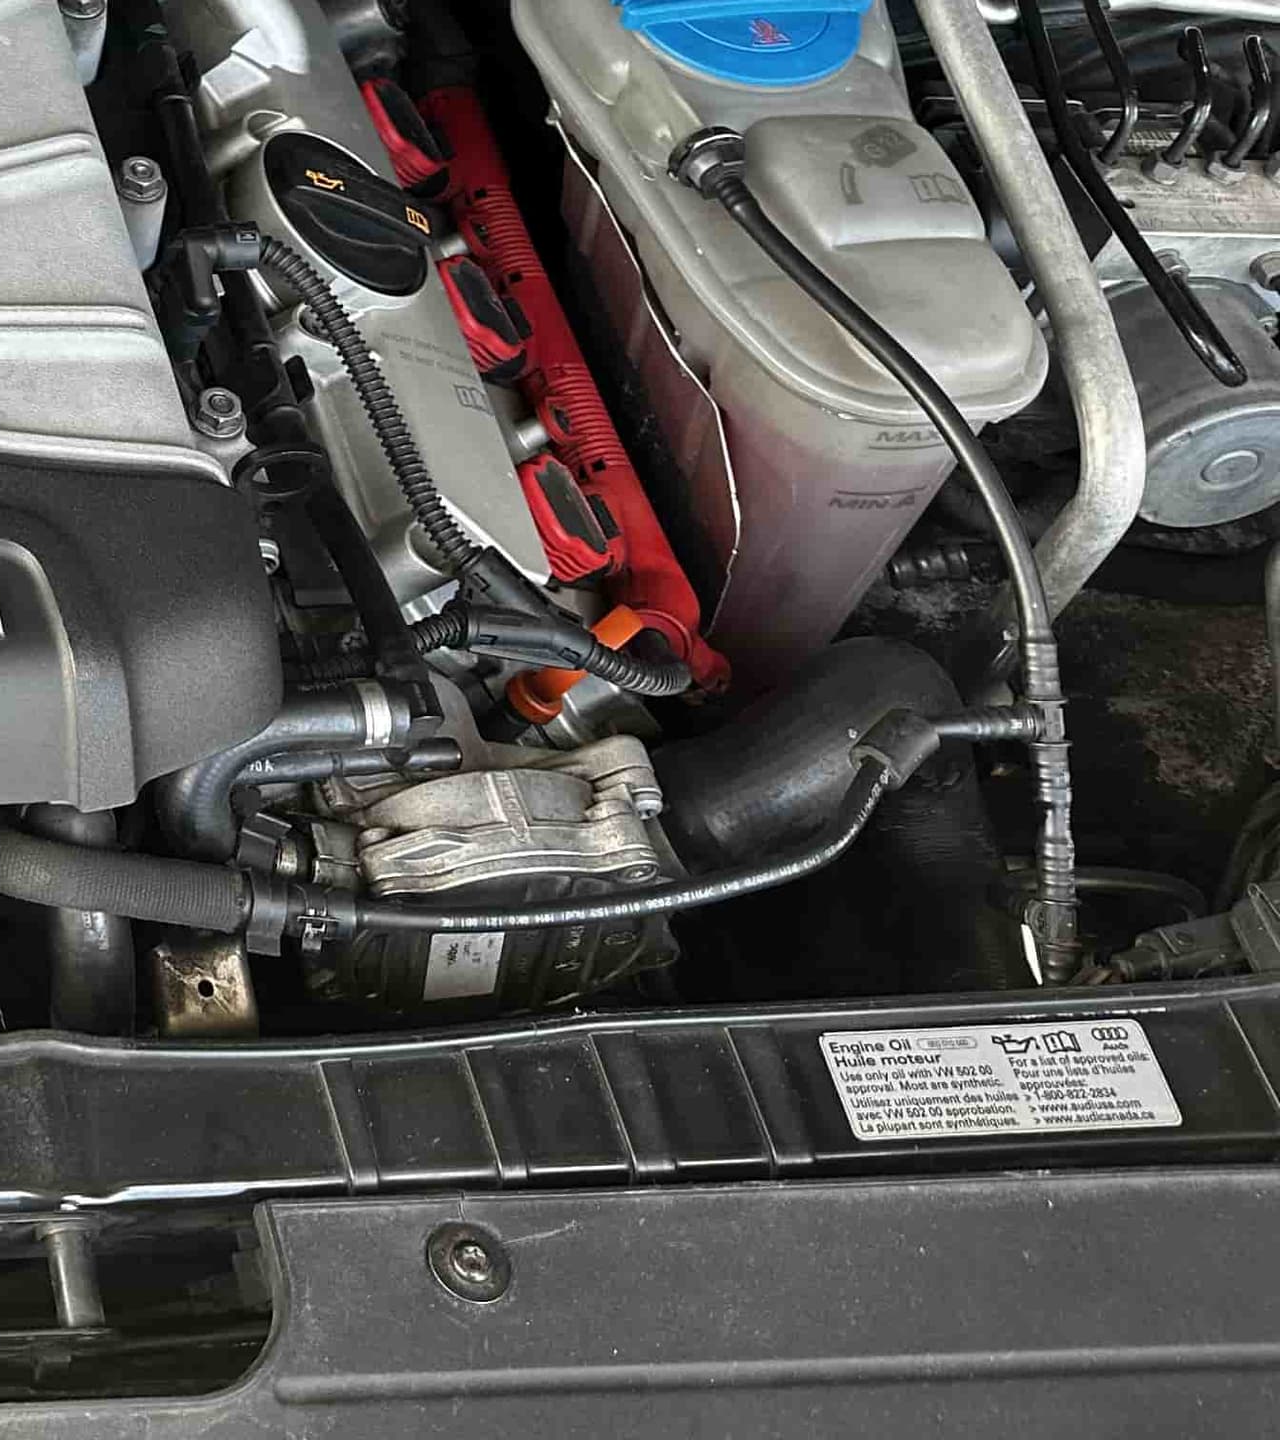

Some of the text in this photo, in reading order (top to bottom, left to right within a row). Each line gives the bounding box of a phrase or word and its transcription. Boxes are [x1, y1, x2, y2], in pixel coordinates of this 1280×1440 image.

[829, 1041, 885, 1056] Engine
[889, 1038, 912, 1052] Oil
[833, 1054, 942, 1068] Huile moteur
[1008, 1056, 1028, 1068] For
[1040, 1054, 1057, 1066] list
[1059, 1054, 1071, 1065] of
[1073, 1051, 1124, 1066] approved
[840, 1064, 993, 1084] Use only oil with VW 502 00
[1013, 1064, 1136, 1079] Pour une liste d'huiles
[900, 1081, 928, 1091] Most
[930, 1081, 949, 1090] are
[950, 1077, 1004, 1091] synthetic.
[849, 1090, 1019, 1109] Utilisez uniquement des huiles
[1034, 1088, 1118, 1101] 1-800-822-2834
[856, 1104, 1016, 1121] avec VW 502 00 approbation.
[859, 1122, 874, 1133] La
[877, 1120, 916, 1134] plupart
[919, 1119, 942, 1130] sont
